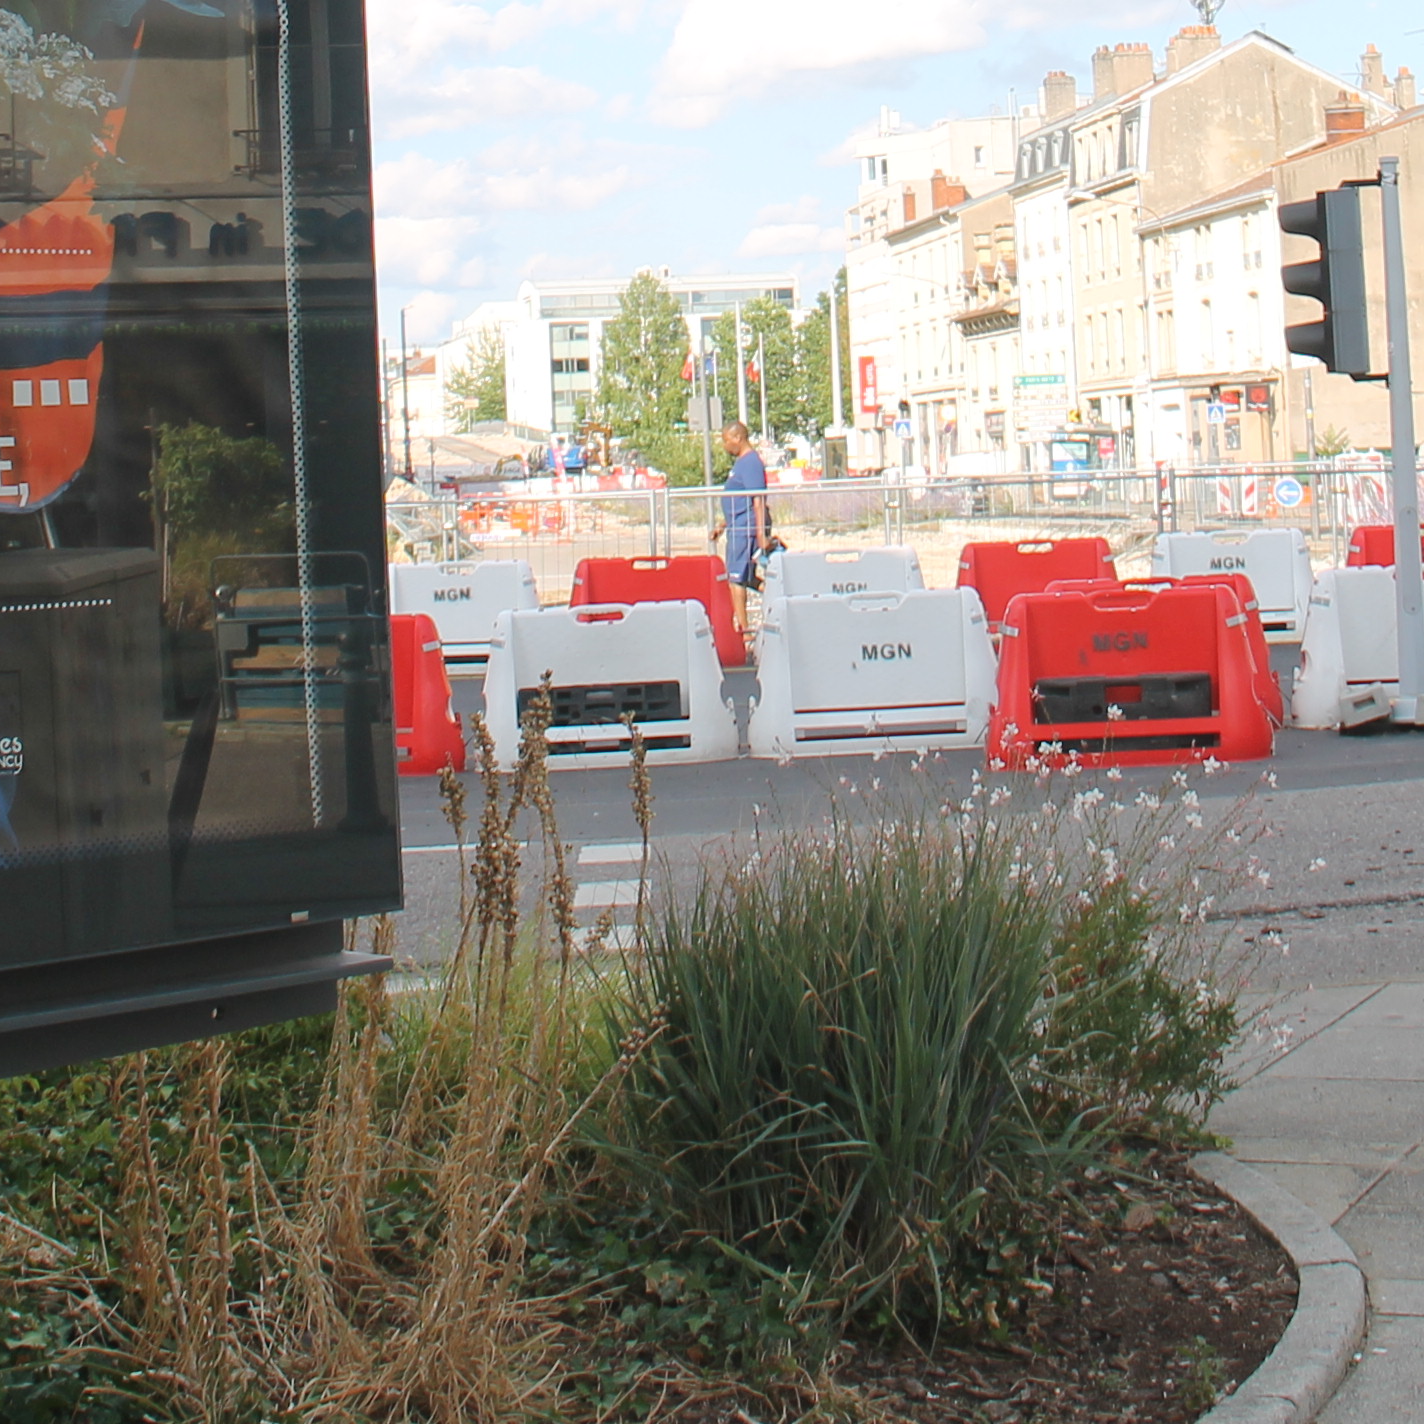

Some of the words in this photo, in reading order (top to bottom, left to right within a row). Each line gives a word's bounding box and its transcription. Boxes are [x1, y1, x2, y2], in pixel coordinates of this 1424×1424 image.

[1210, 556, 1246, 570] MGN
[433, 587, 471, 603] MGN
[1093, 631, 1149, 652] MGN
[861, 642, 912, 662] MGN
